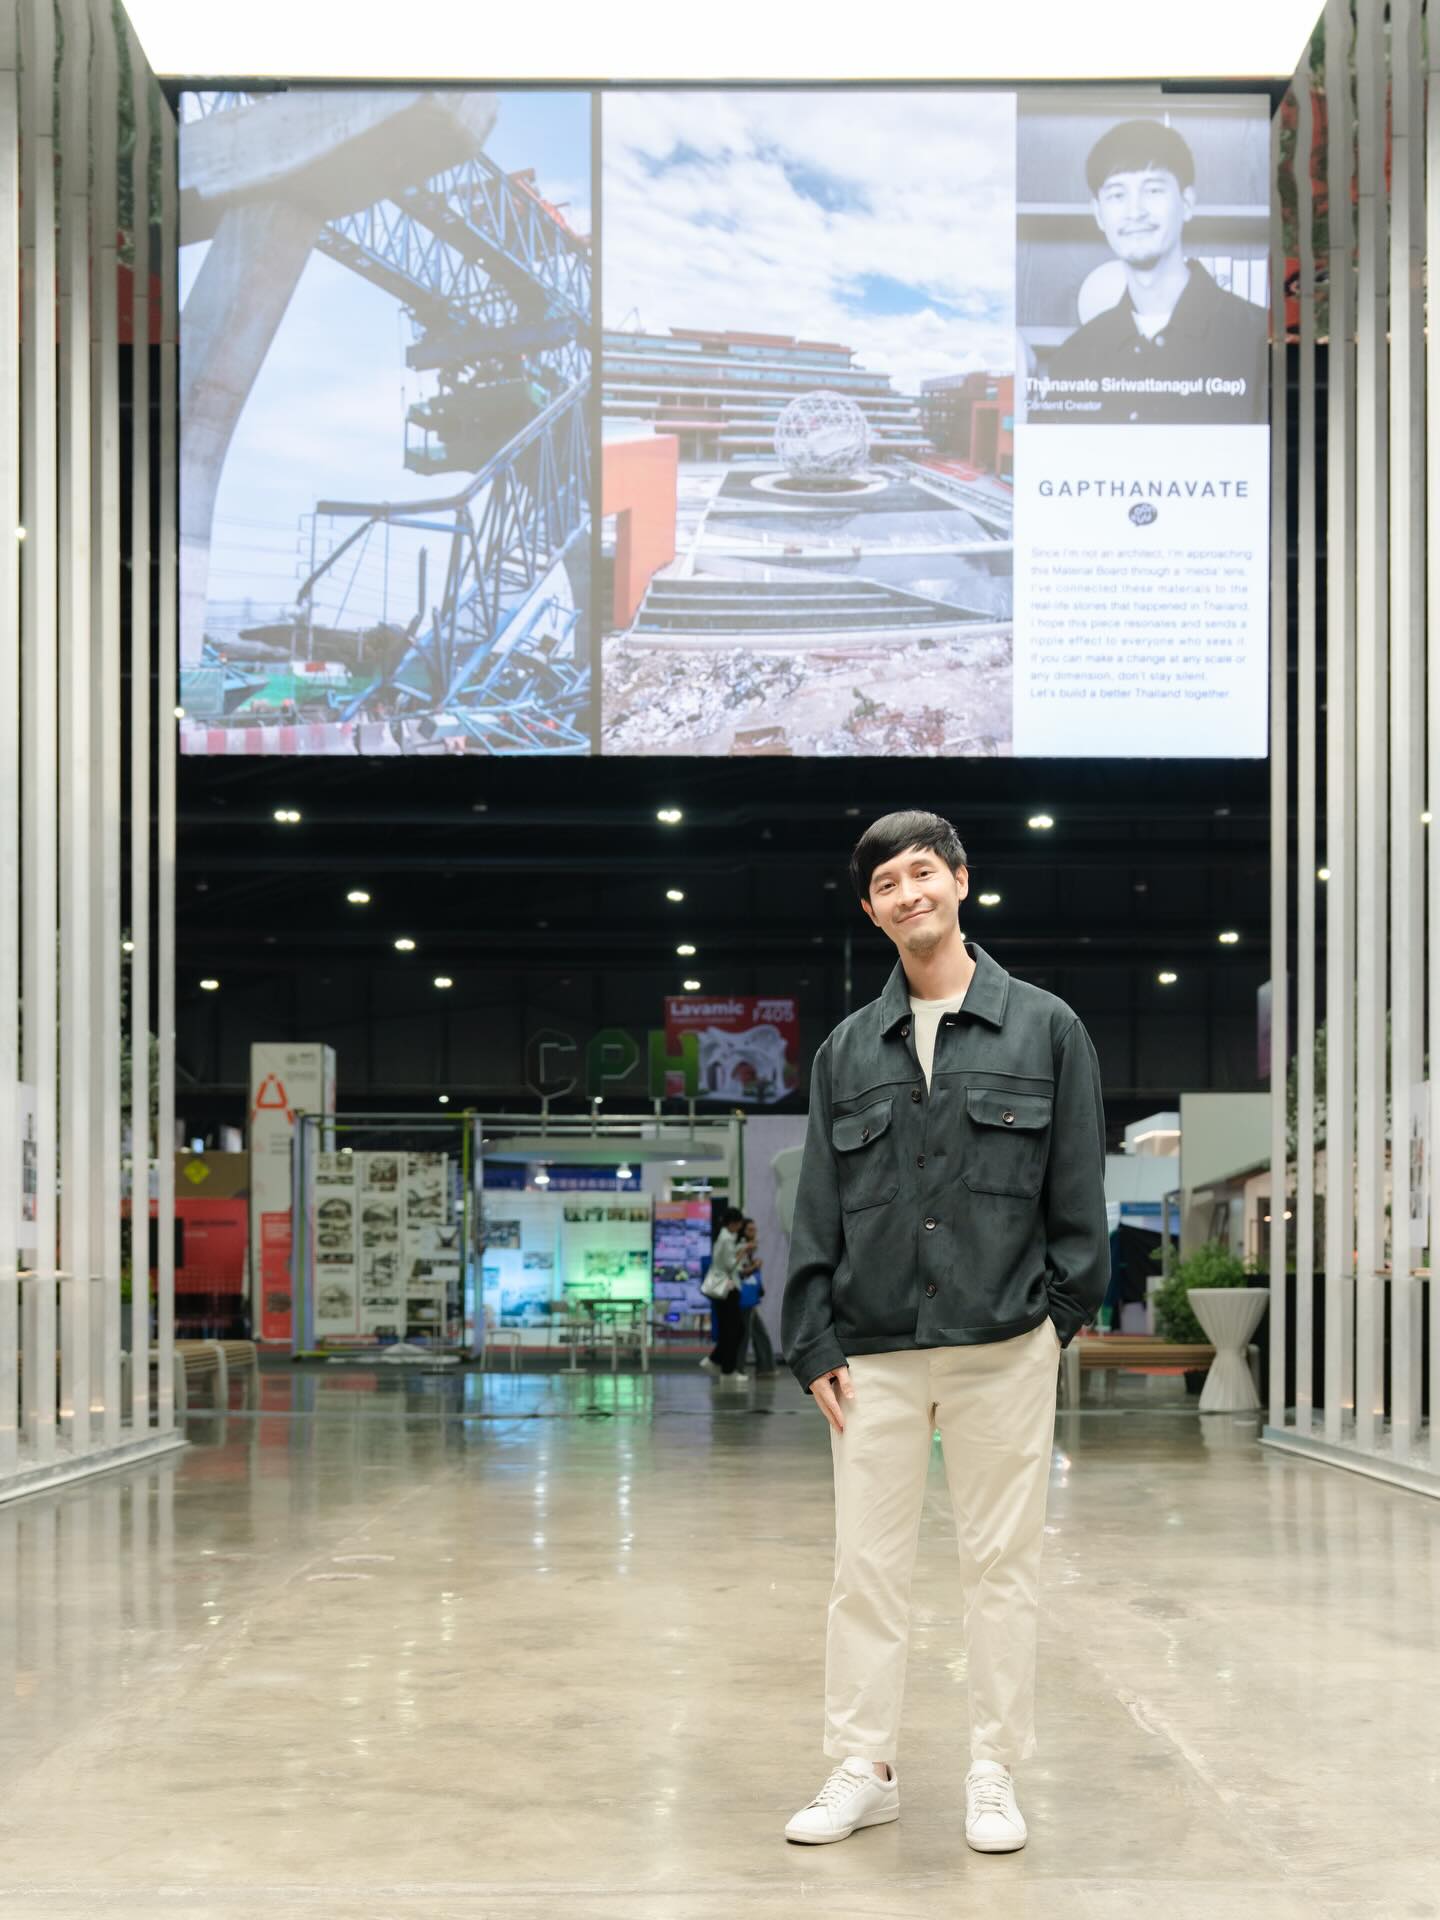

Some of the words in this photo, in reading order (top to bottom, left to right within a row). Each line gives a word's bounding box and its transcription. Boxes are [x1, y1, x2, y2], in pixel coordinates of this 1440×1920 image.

[1101, 377, 1203, 395] Siriwattanagul
[1205, 377, 1246, 395] (Gap)
[1065, 400, 1102, 411] Creator
[1038, 481, 1249, 498] GAPTHANAVATE
[1031, 547, 1060, 559] Since
[1081, 547, 1098, 559] not
[1101, 549, 1115, 559] an
[1186, 547, 1253, 561] approaching
[1030, 566, 1050, 576] this
[1052, 566, 1093, 576] Material
[1096, 566, 1128, 576] Board
[1131, 566, 1170, 578] through
[1055, 583, 1117, 593] connected
[1121, 583, 1153, 593] these
[1157, 583, 1211, 593] materials
[1215, 583, 1226, 593] to
[1230, 583, 1248, 593] the
[1072, 600, 1107, 611] stories
[1110, 600, 1131, 611] that
[1133, 600, 1187, 613] happened
[1190, 600, 1200, 611] in
[1037, 618, 1065, 630] hope
[1068, 618, 1087, 628] this
[1090, 618, 1121, 630] piece
[1124, 618, 1177, 628] resonates
[1180, 618, 1201, 628] and
[1204, 618, 1237, 628] sends
[1240, 620, 1247, 628] a
[1030, 635, 1065, 648] ripple
[1068, 635, 1102, 646] effect
[1106, 635, 1118, 646] to
[1121, 637, 1174, 648] everyone
[1178, 635, 1201, 646] who
[1206, 637, 1233, 646] sees
[1040, 655, 1060, 665] you
[1062, 655, 1083, 663] can
[1086, 653, 1114, 663] make
[1117, 655, 1123, 663] a
[1126, 653, 1166, 665] change
[1169, 653, 1179, 663] at
[1182, 655, 1201, 665] any
[1204, 653, 1232, 663] scale
[1235, 655, 1246, 663] or
[1030, 672, 1049, 683] any
[1150, 670, 1172, 683] stay
[1059, 687, 1087, 699] build
[1090, 689, 1096, 699] a
[1099, 687, 1132, 699] better
[1136, 687, 1182, 699] Thailand
[671, 1000, 743, 1017] Lavamic
[526, 1028, 700, 1100] CPH
